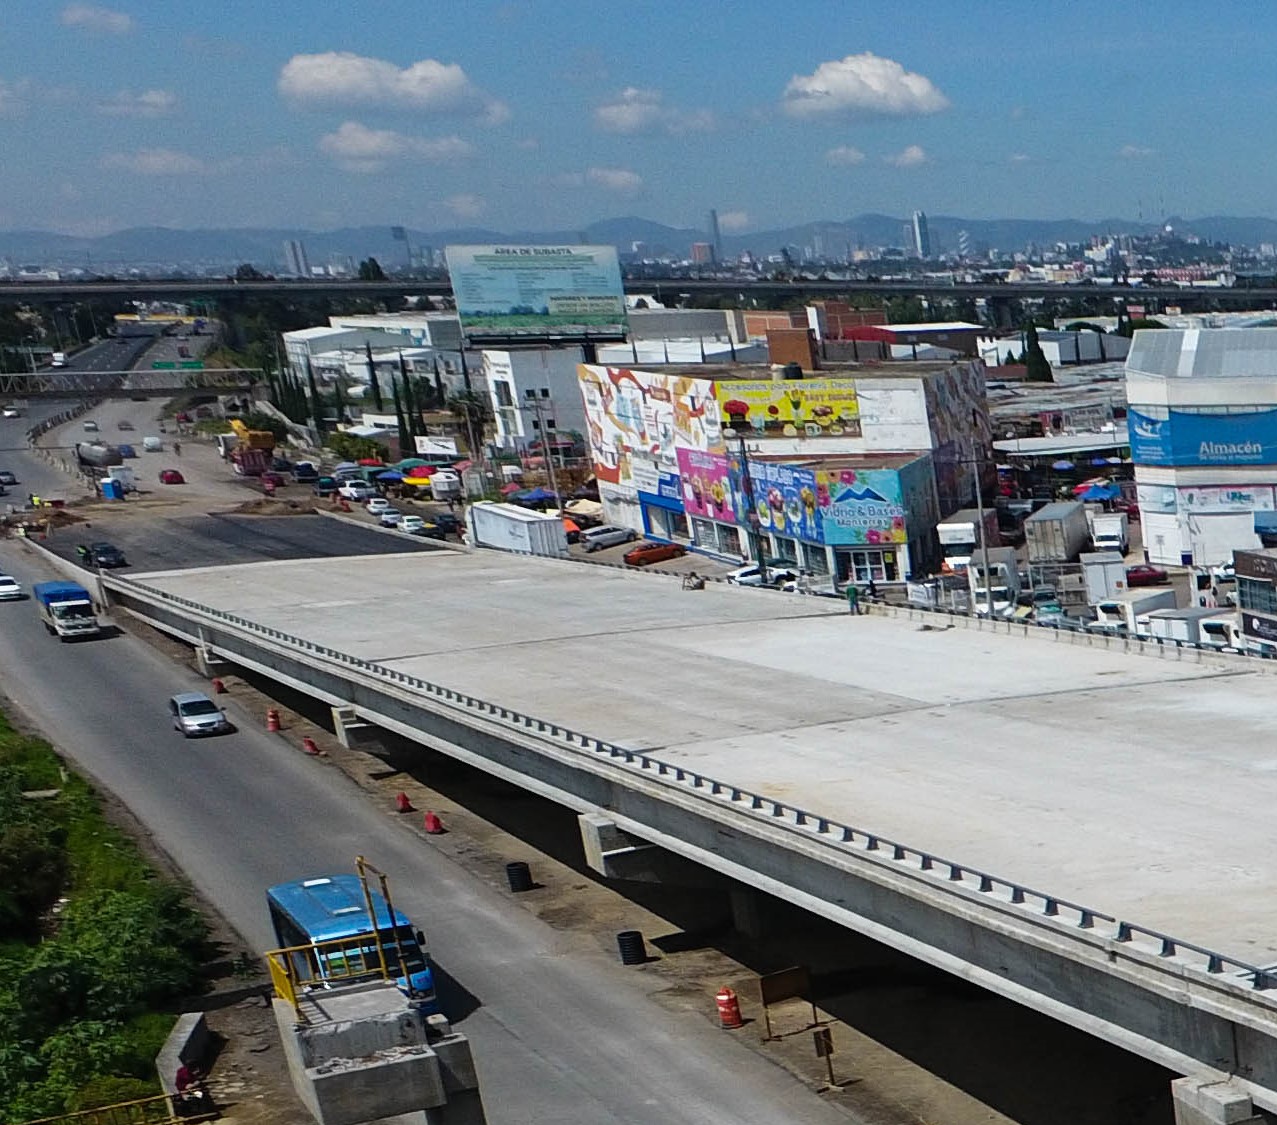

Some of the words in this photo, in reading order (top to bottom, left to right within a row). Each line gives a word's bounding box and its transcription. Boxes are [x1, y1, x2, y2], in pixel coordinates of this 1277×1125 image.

[1199, 440, 1262, 454] Almacén
[822, 504, 855, 518] Vidrio
[857, 506, 867, 516] &
[868, 503, 904, 516] Bases
[836, 518, 888, 529] Monterrey
